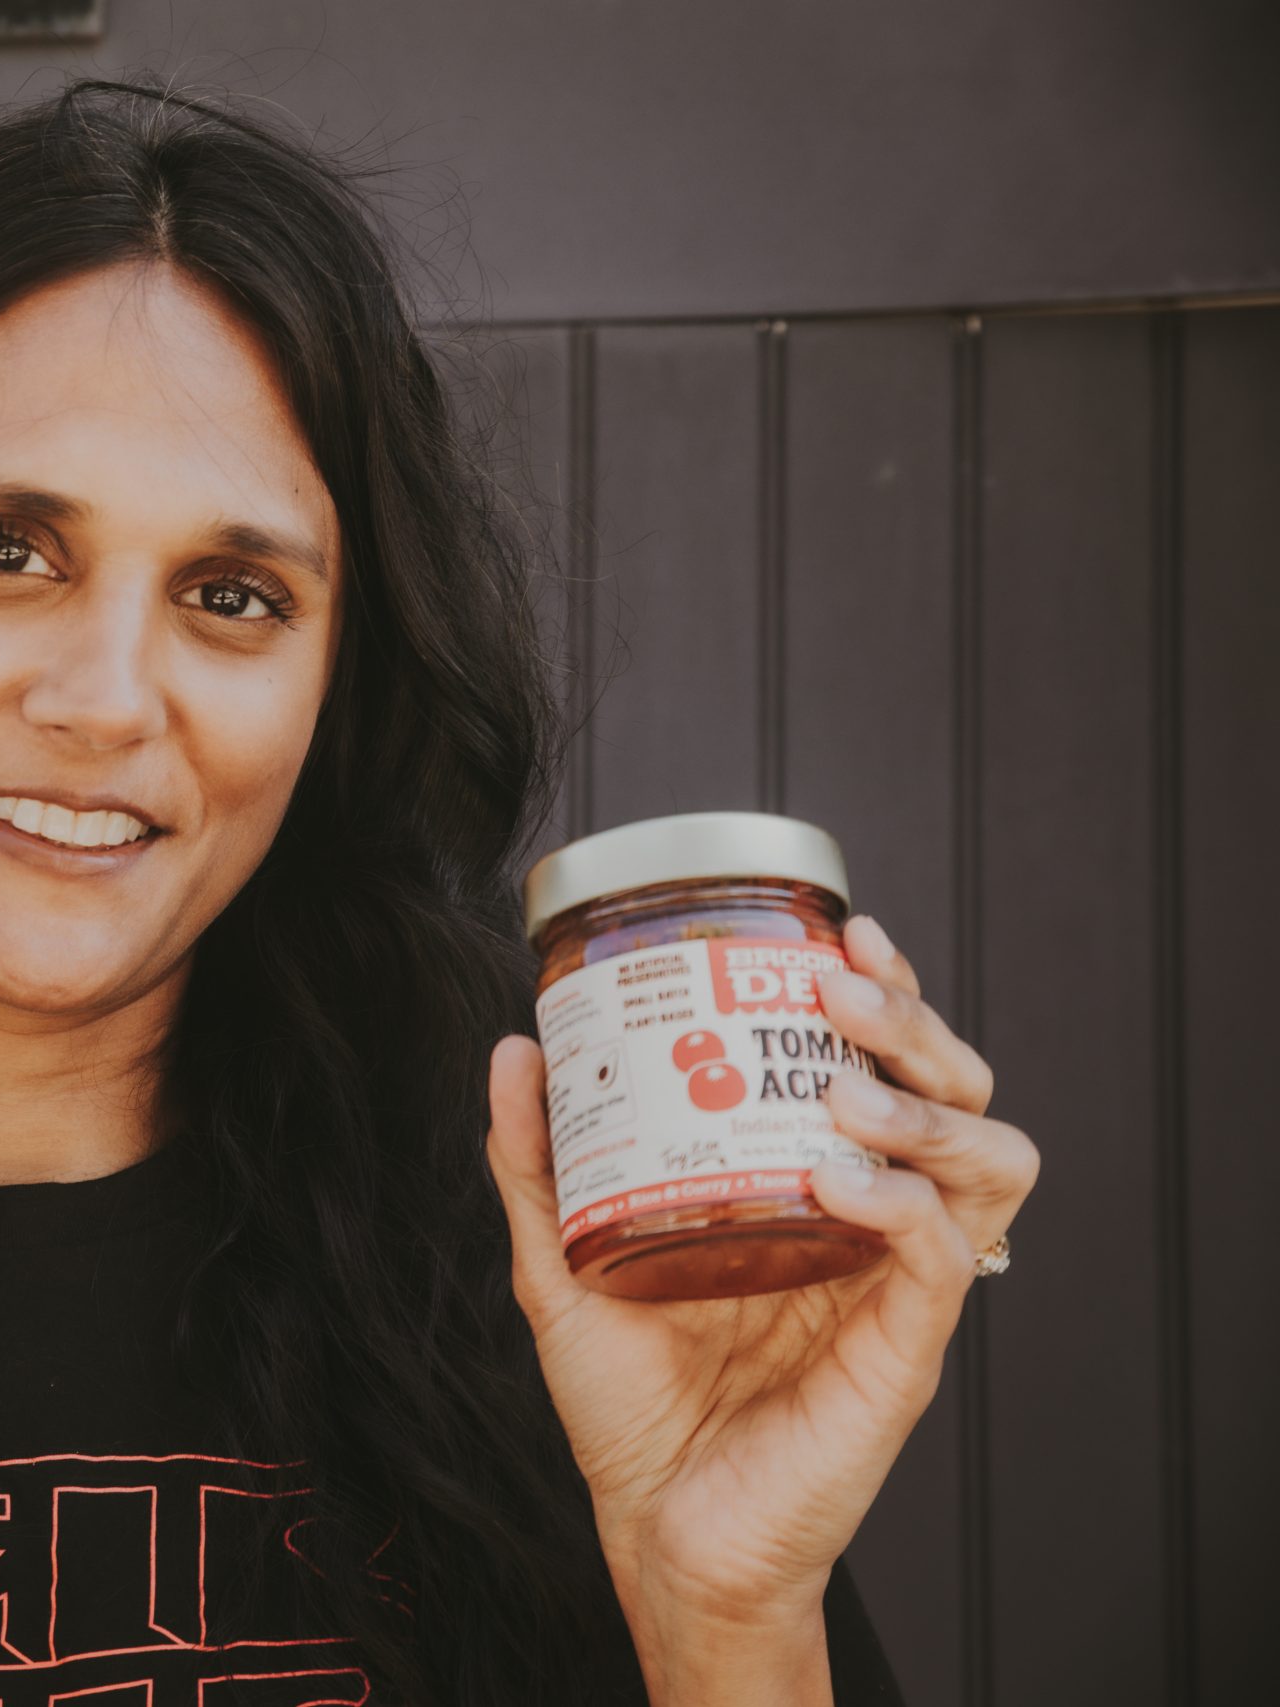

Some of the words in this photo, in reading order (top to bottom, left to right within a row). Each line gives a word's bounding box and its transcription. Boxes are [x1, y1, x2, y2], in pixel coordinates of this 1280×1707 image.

[752, 1028, 874, 1076] TOMAT
[760, 1069, 831, 1101] ACH
[730, 1118, 795, 1136] Indian
